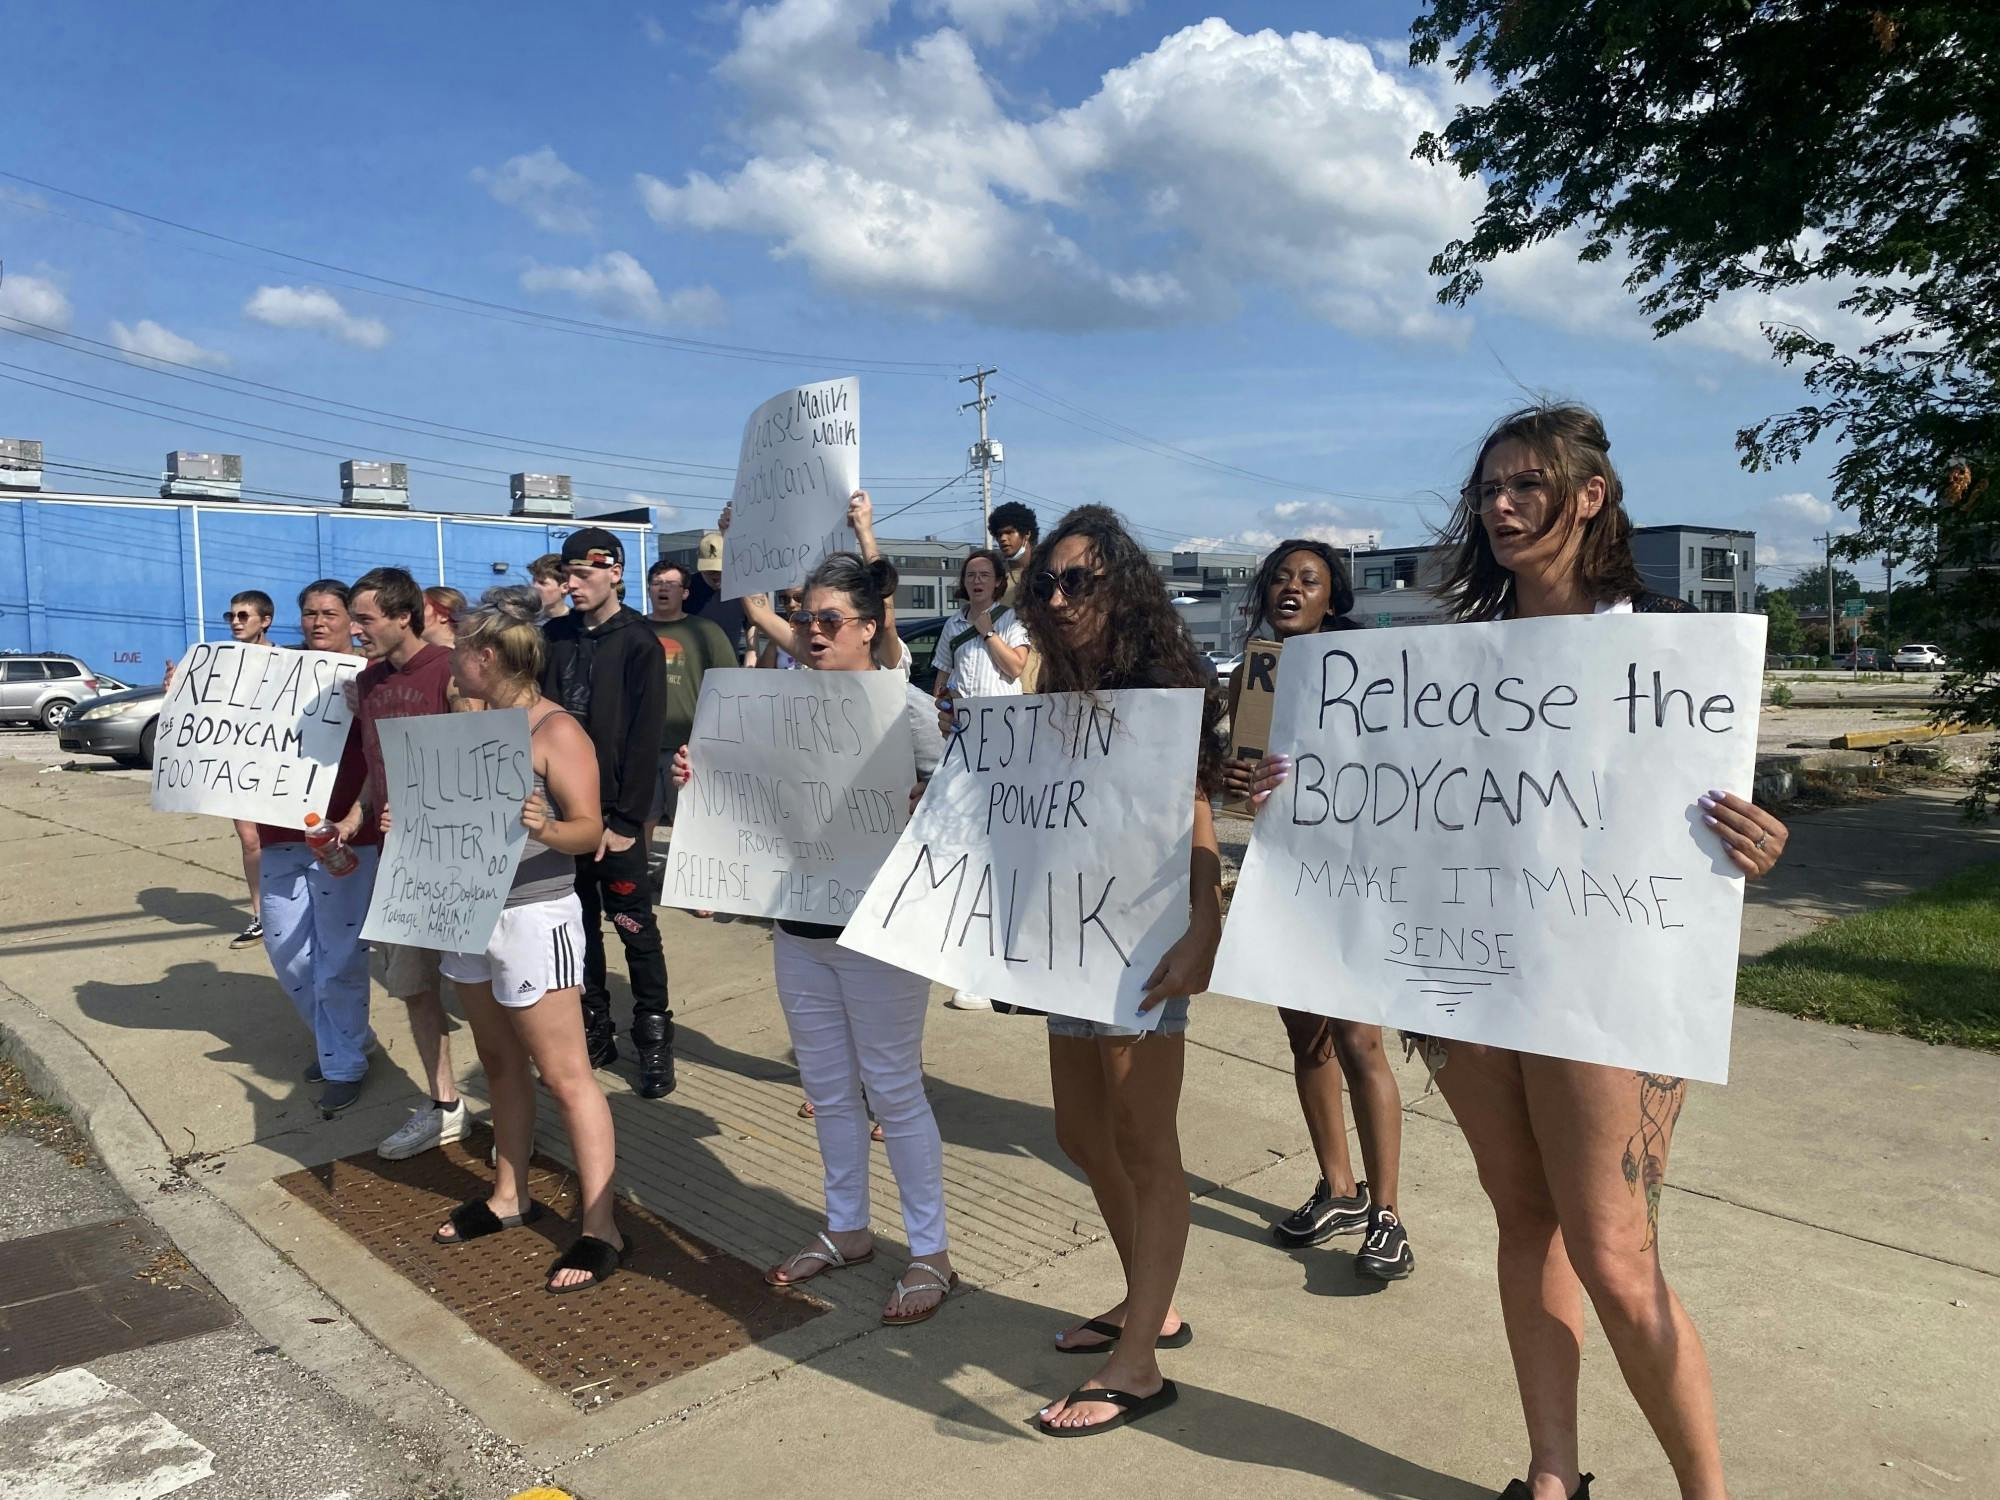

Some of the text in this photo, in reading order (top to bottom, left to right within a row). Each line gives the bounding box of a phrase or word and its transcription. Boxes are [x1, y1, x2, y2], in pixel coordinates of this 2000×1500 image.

[113, 651, 142, 663] LOVE
[174, 644, 357, 725] RELEASE
[700, 688, 749, 743] IF
[1319, 649, 1735, 737] Release the
[160, 716, 175, 731] THE
[177, 713, 303, 758] BODYCAM
[942, 704, 1116, 773] REST IN
[157, 757, 318, 803] FOOTAGE!
[691, 768, 904, 834] NOTHING TO HIDE
[986, 780, 1088, 835] POWER
[1292, 753, 1604, 832] BODYCAM!
[738, 829, 785, 859] PROVE
[384, 856, 447, 903] Release
[674, 851, 751, 901] RELEASE
[772, 870, 815, 912] THE
[1295, 860, 1684, 929] MAKE IT MAKE
[882, 844, 1131, 971] MALIK
[1389, 922, 1515, 969] SENSE
